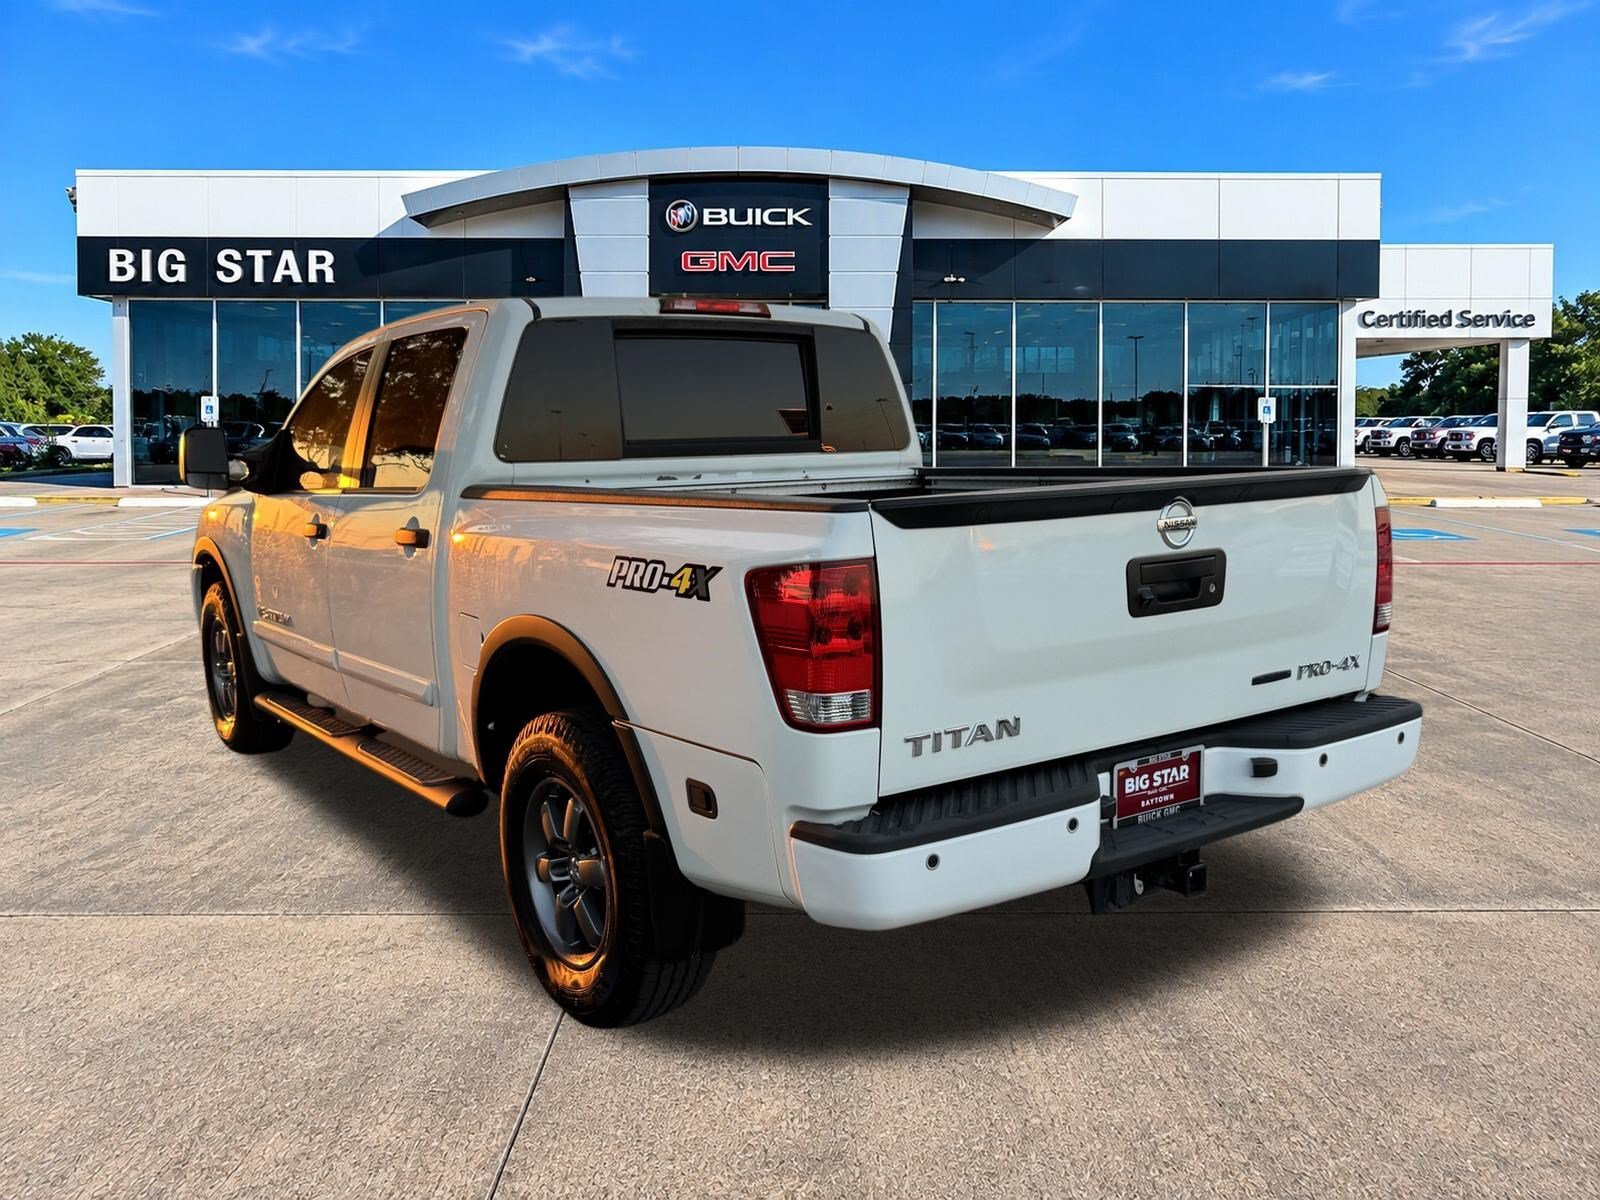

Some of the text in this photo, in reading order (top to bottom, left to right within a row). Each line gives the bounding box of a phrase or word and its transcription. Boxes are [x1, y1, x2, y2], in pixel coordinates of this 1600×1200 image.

[703, 207, 813, 226] BUICK
[108, 248, 336, 284] BIG STAR
[681, 250, 796, 272] GMC
[1360, 309, 1536, 329] Certified Service
[1164, 518, 1197, 529] NISSAN
[1296, 654, 1361, 681] PRO-4X
[903, 715, 1021, 758] TITAN
[1125, 764, 1189, 793] BIG STAR
[1141, 793, 1174, 807] BAYTOWN
